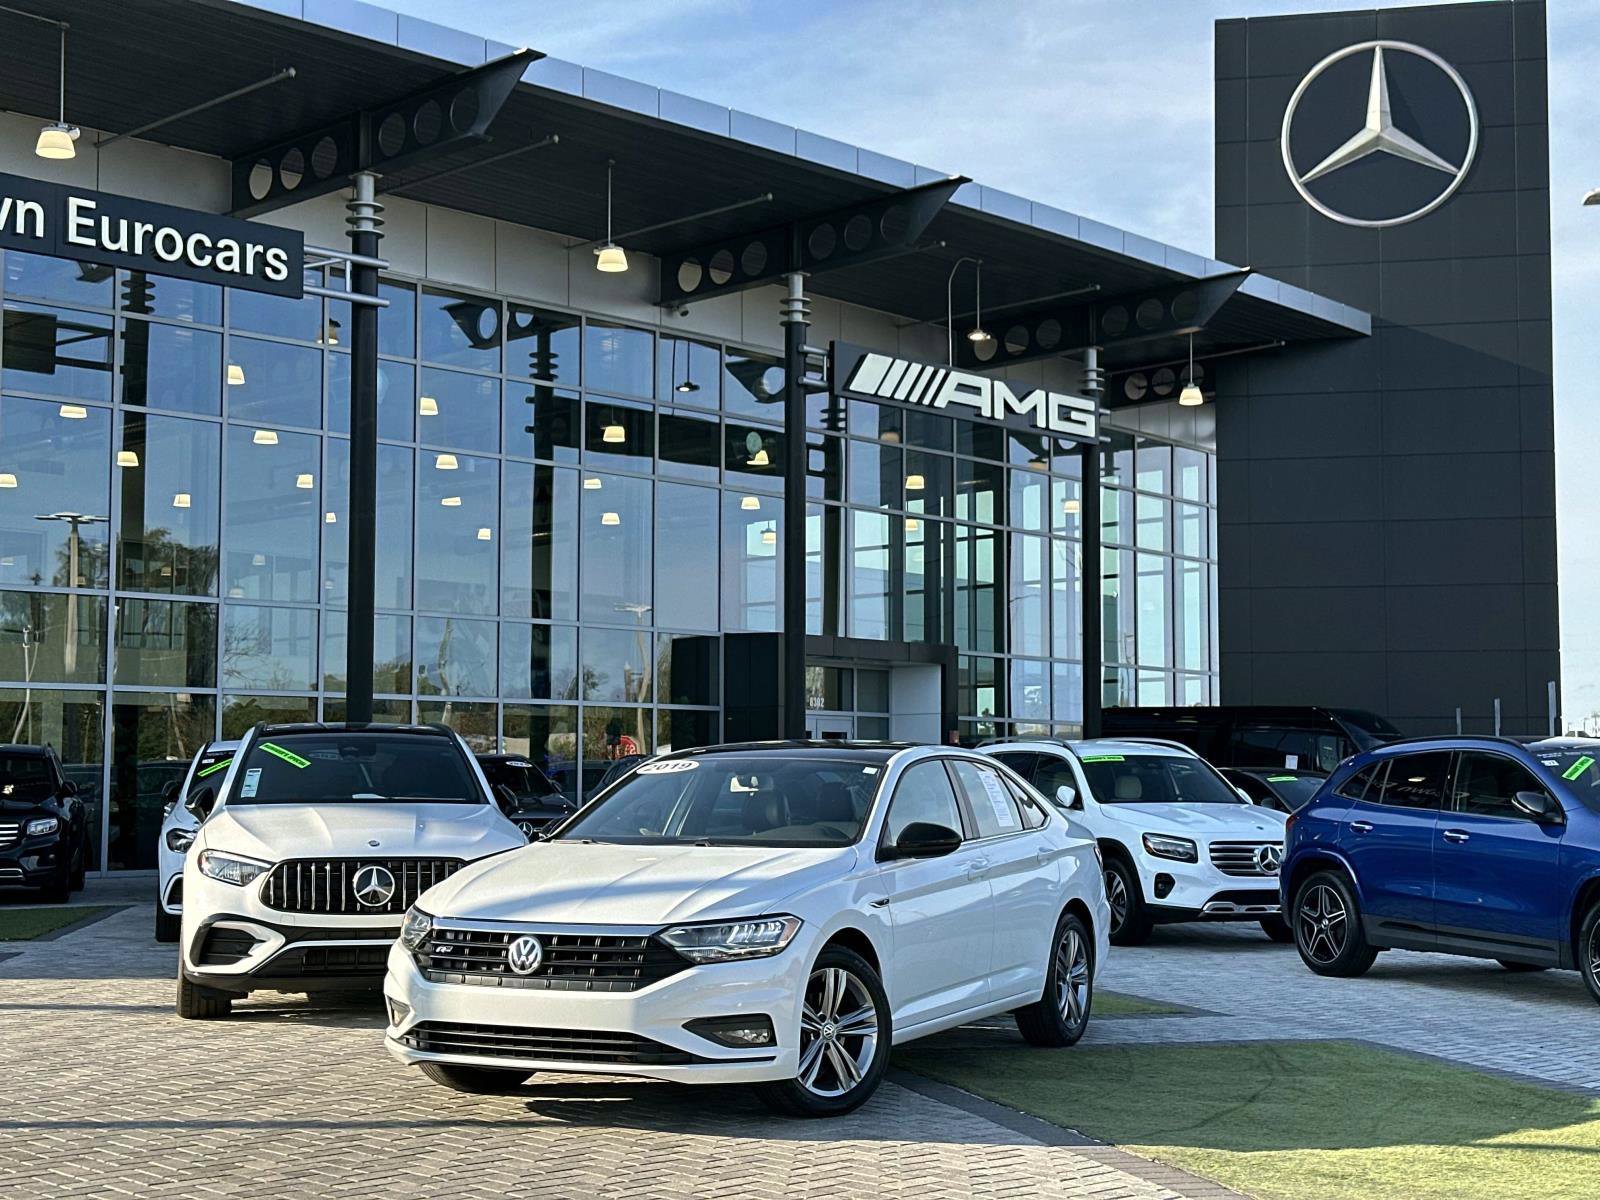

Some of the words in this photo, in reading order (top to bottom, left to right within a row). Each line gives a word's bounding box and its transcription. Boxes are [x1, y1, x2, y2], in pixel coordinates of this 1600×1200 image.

[67, 196, 289, 281] Eurocars
[933, 370, 1096, 438] AMG
[508, 936, 542, 975] VW
